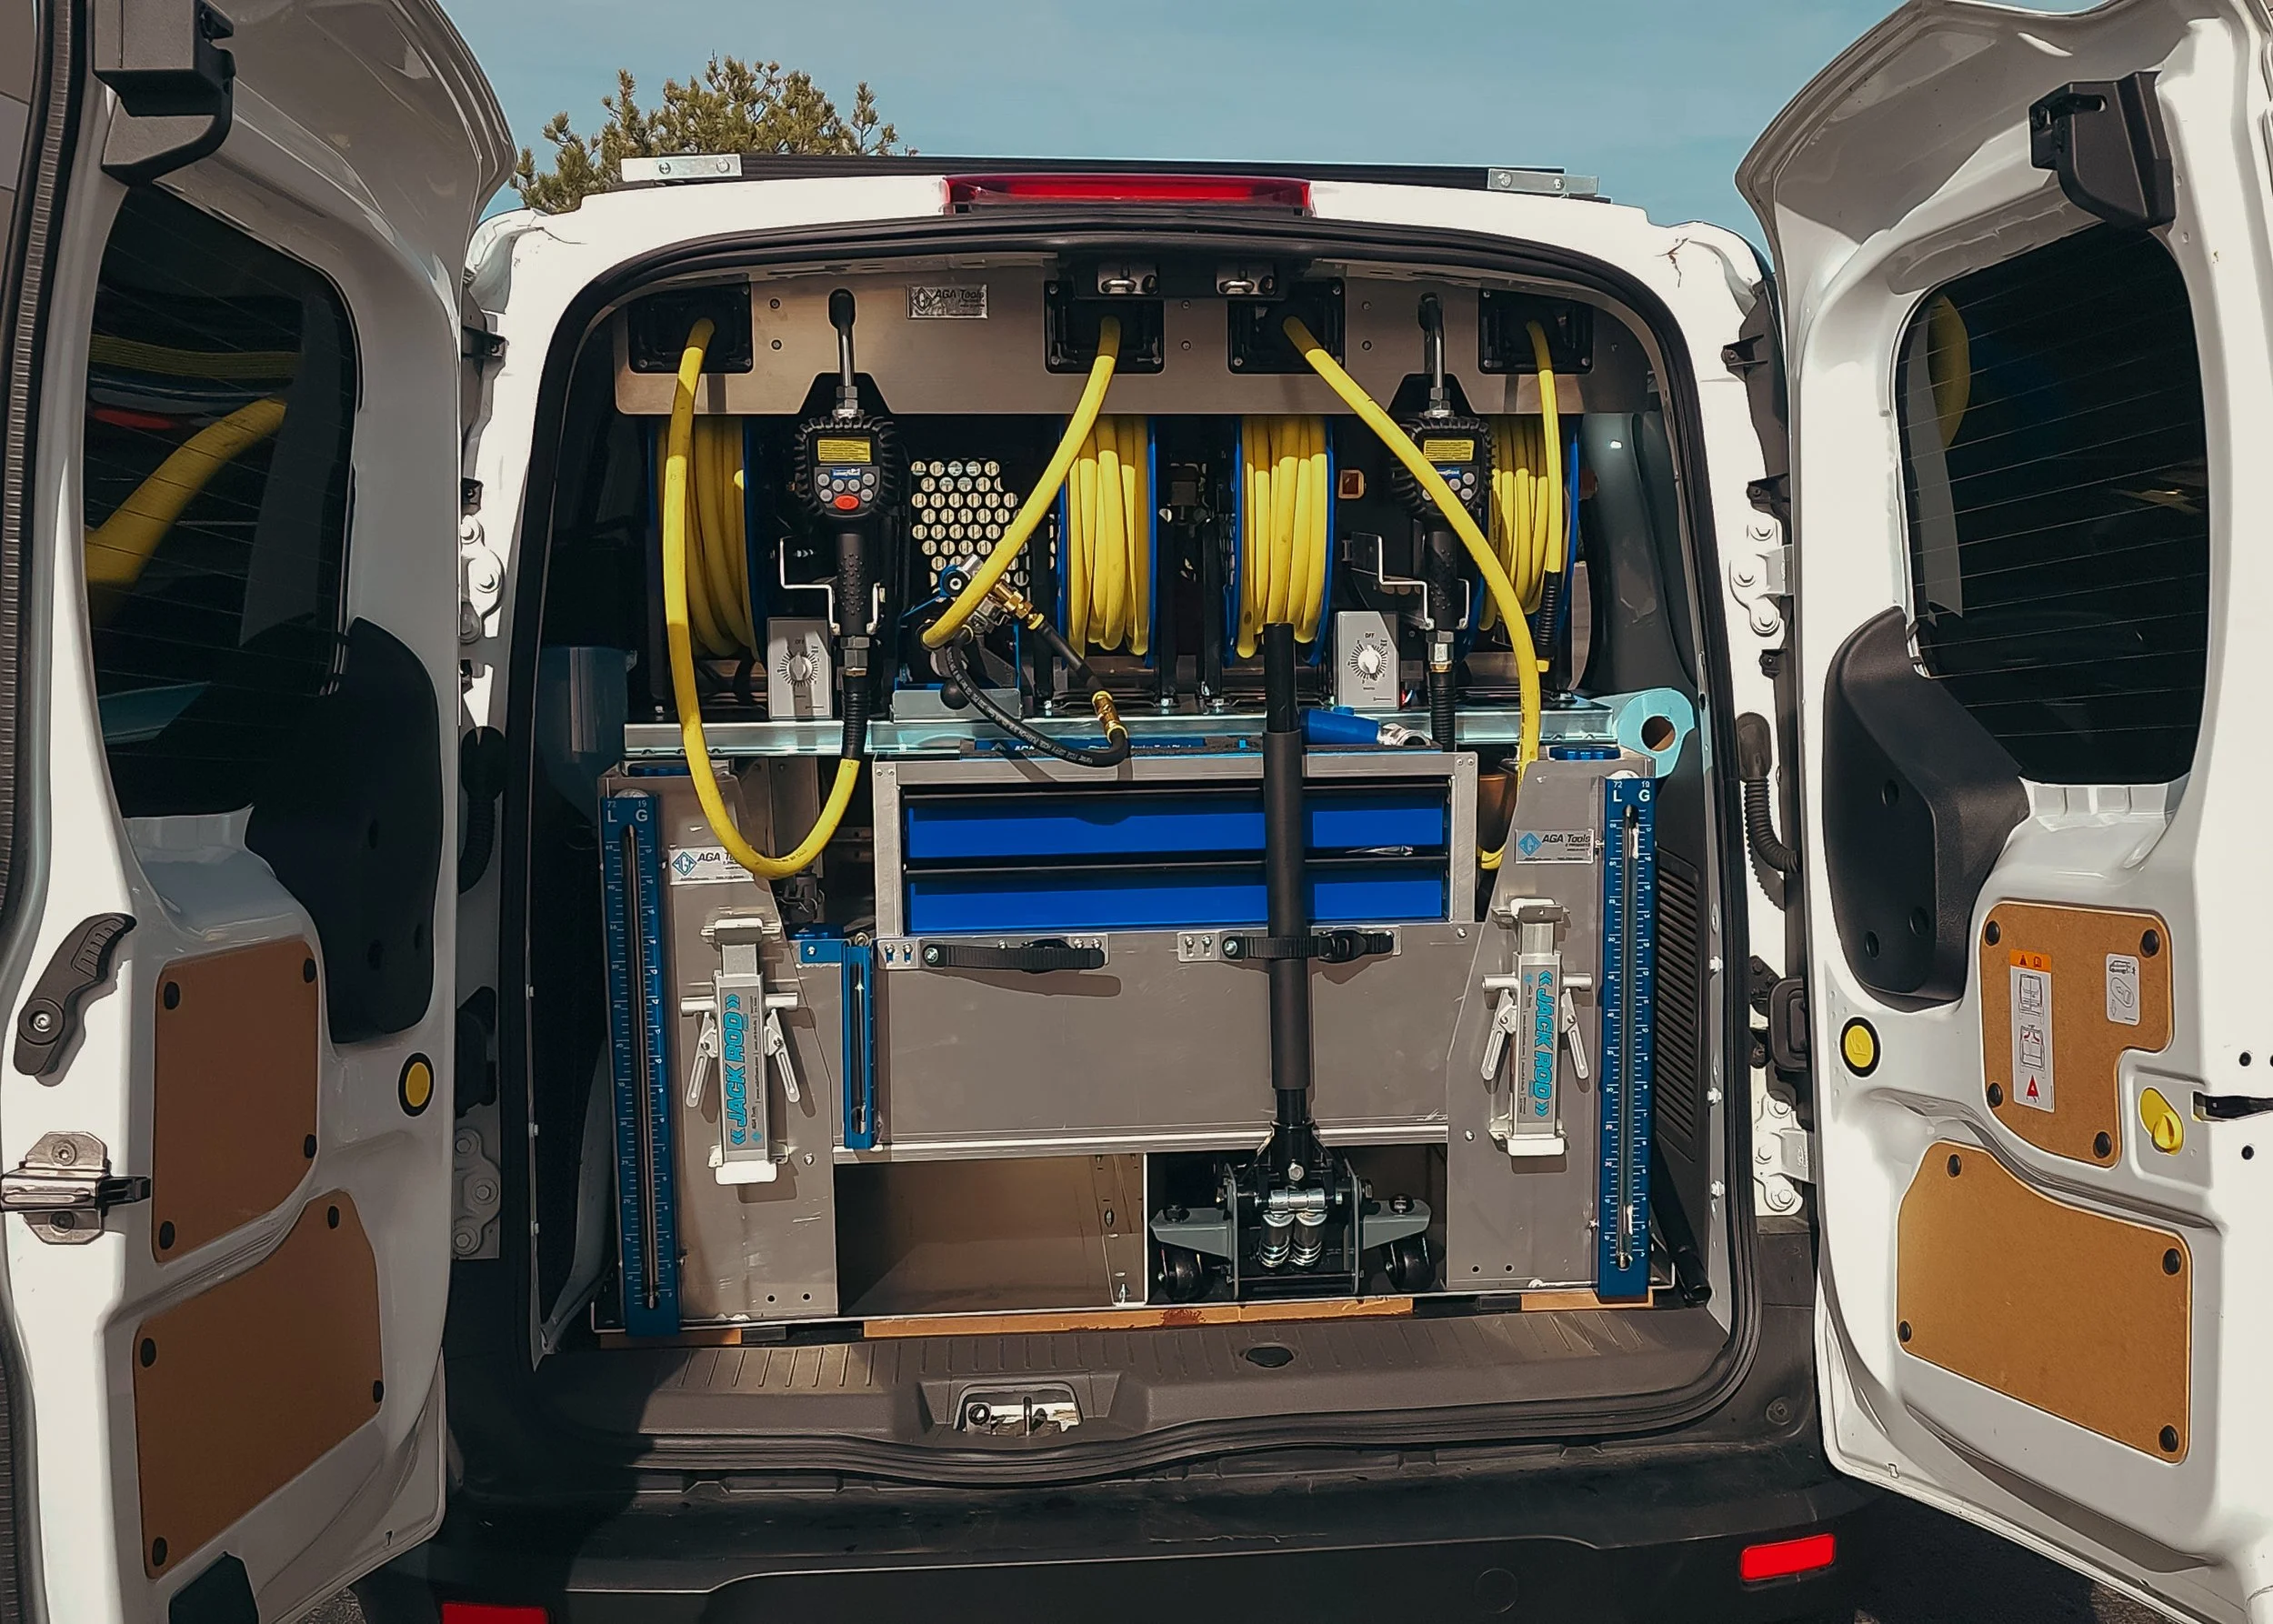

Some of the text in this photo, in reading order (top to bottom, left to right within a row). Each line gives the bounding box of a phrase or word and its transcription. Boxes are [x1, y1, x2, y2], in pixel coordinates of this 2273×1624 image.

[934, 289, 956, 299] AGA
[1613, 788, 1650, 802] L G
[606, 800, 617, 808] 72
[607, 808, 648, 823] L G
[1541, 834, 1590, 843] AGA Tools
[696, 852, 721, 862] AGA
[1533, 987, 1555, 1100] JACK ROD
[724, 1011, 747, 1128] JACK ROD
